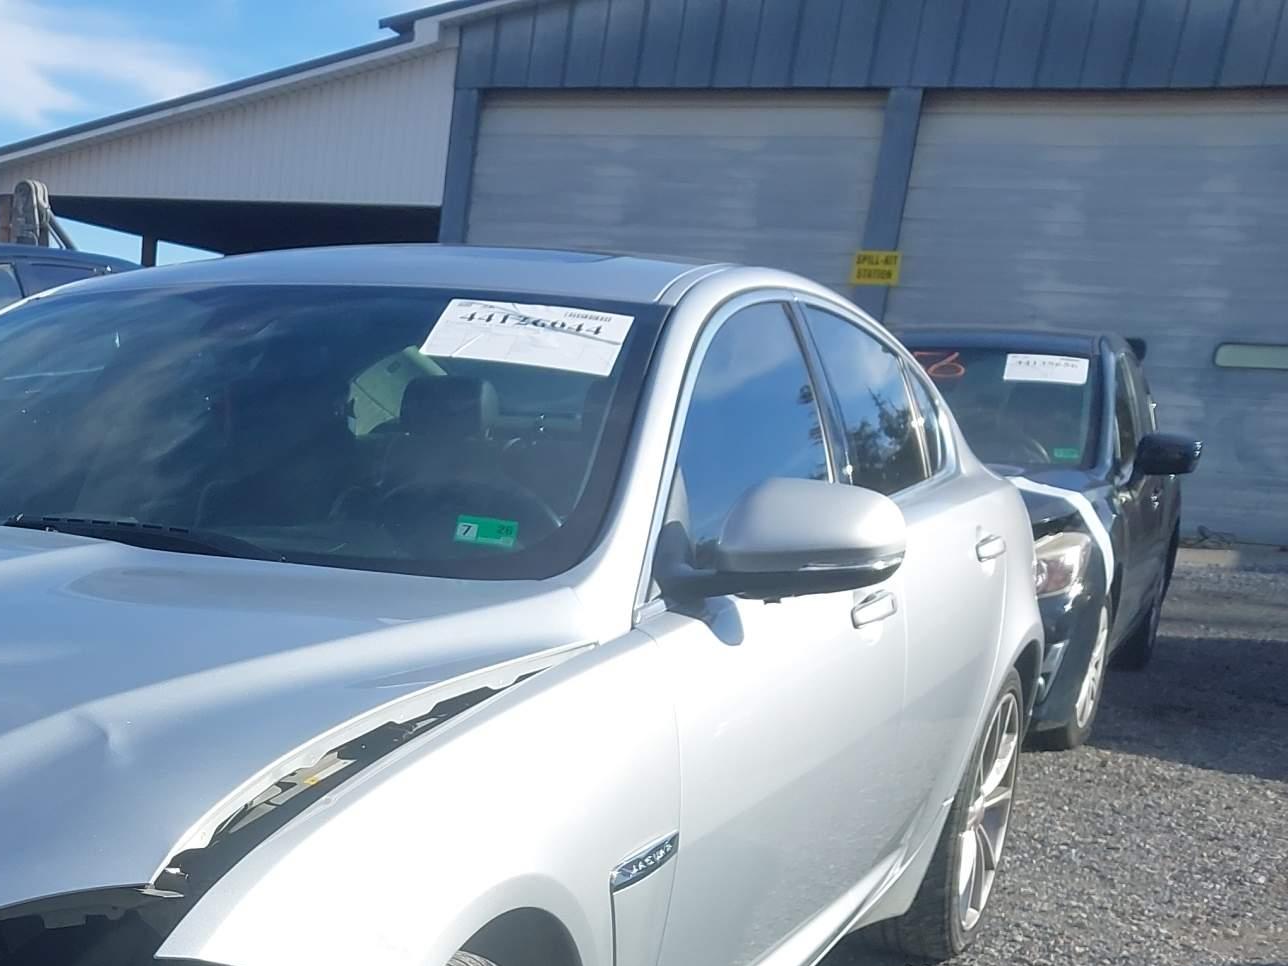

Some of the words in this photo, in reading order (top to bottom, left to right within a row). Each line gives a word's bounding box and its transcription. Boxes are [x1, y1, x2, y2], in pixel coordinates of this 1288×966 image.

[856, 268, 892, 279] STATION
[460, 311, 604, 336] 44126044
[462, 524, 473, 536] 7
[630, 841, 672, 876] JAGUAR
